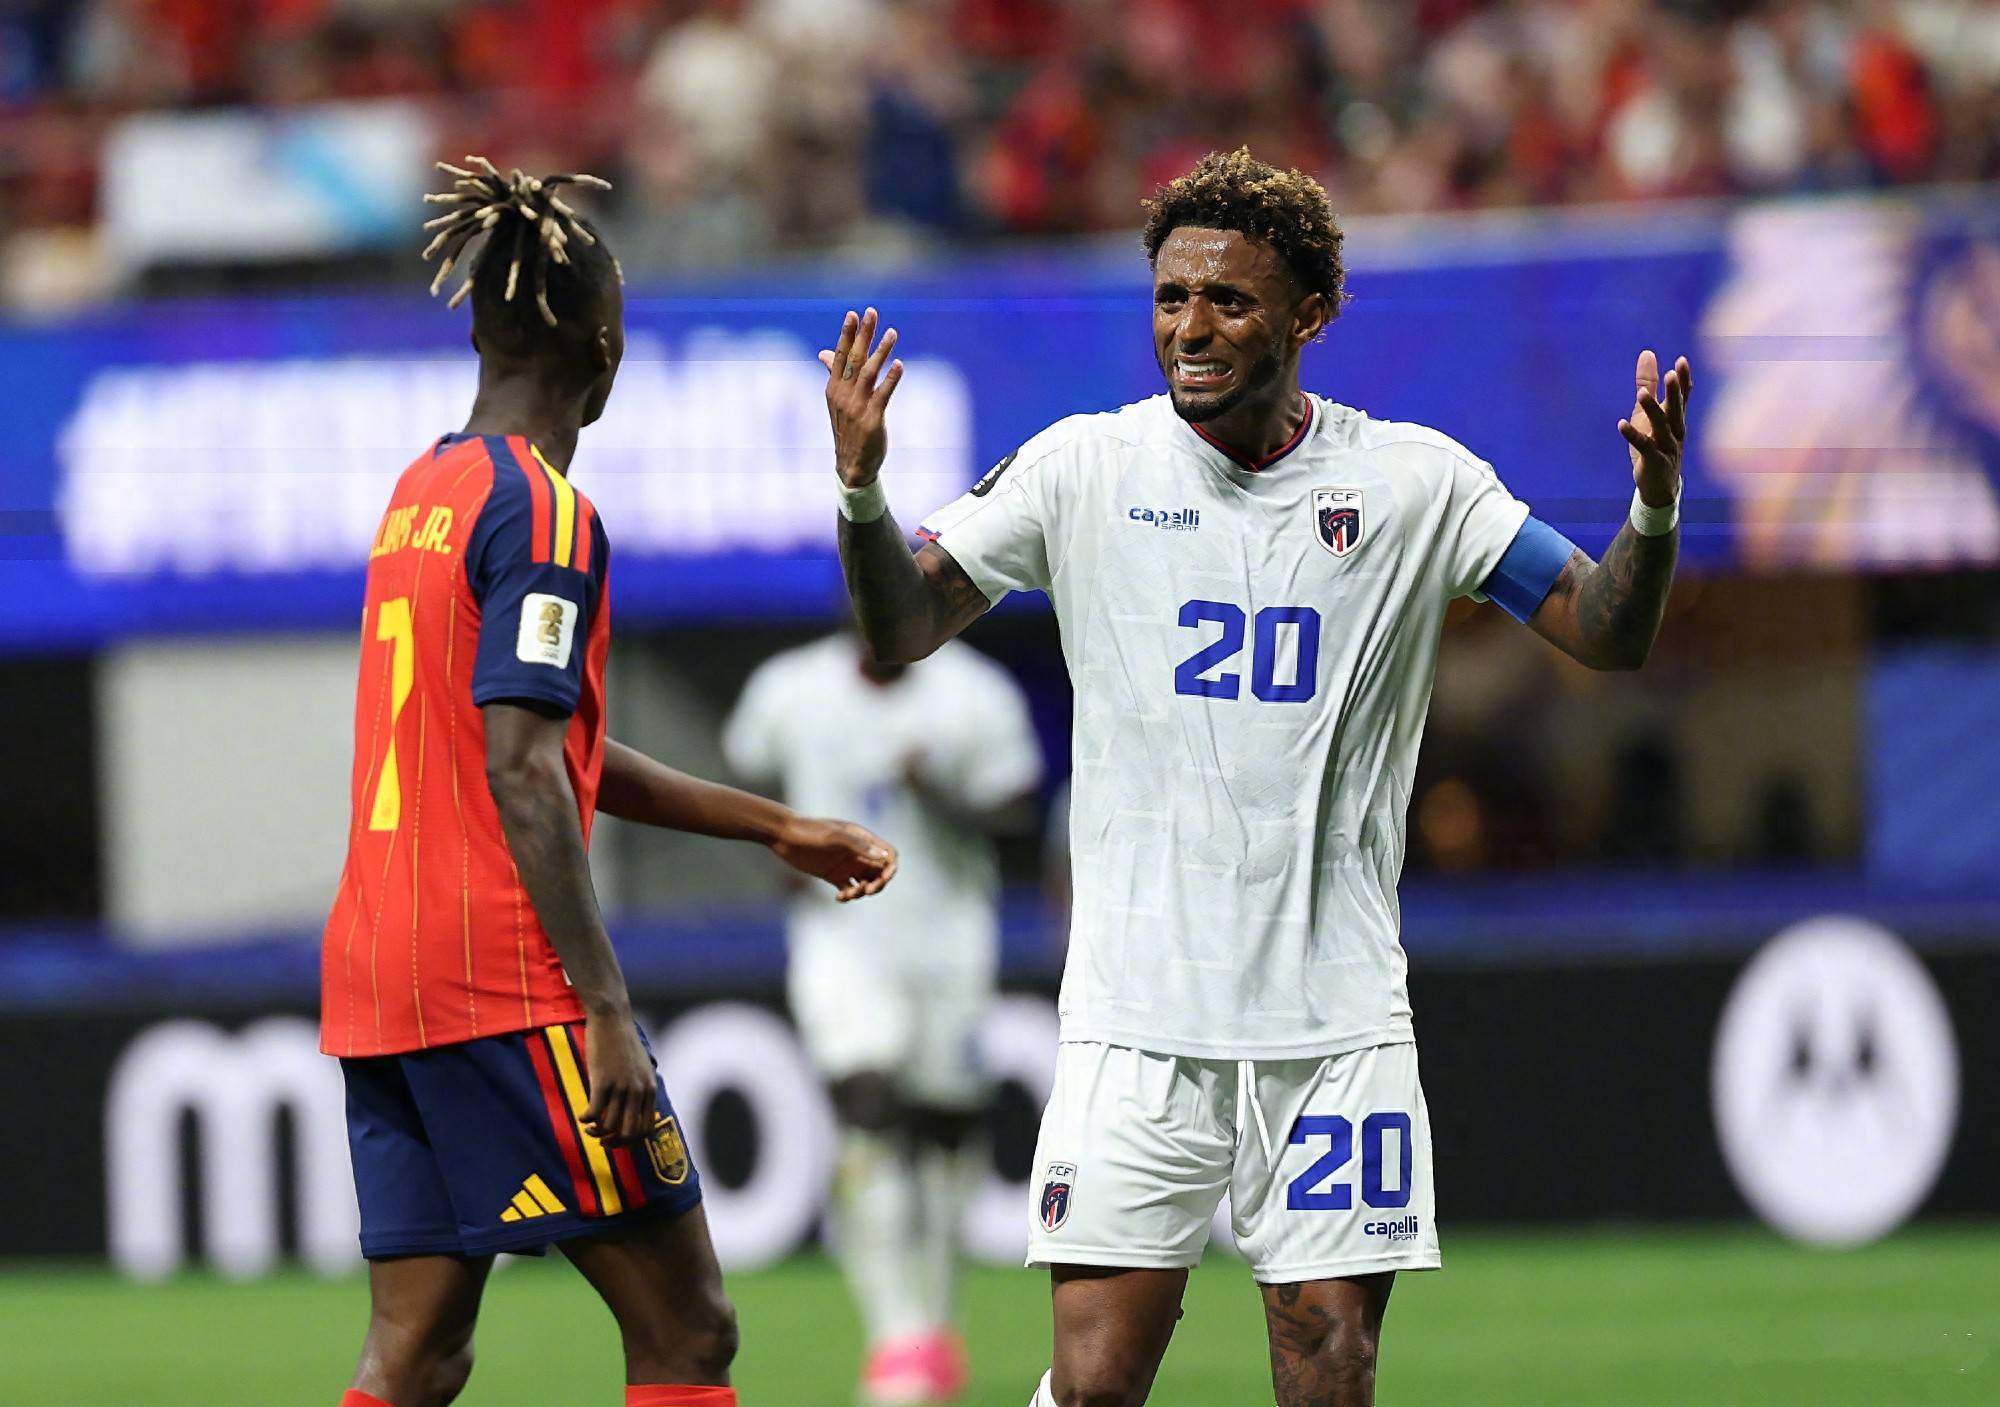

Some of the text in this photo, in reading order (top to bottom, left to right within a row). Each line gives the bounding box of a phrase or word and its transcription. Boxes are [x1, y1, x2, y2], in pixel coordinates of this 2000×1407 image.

[1317, 492, 1359, 502] FCF
[1128, 508, 1200, 527] capelli
[411, 505, 454, 555] JR.
[1160, 522, 1199, 533] SPORT
[1174, 599, 1321, 703] 20
[1047, 1165, 1074, 1177] FCF
[1286, 1112, 1413, 1211] 20
[1363, 1215, 1419, 1240] capelli
[1392, 1233, 1419, 1241] SPORT
